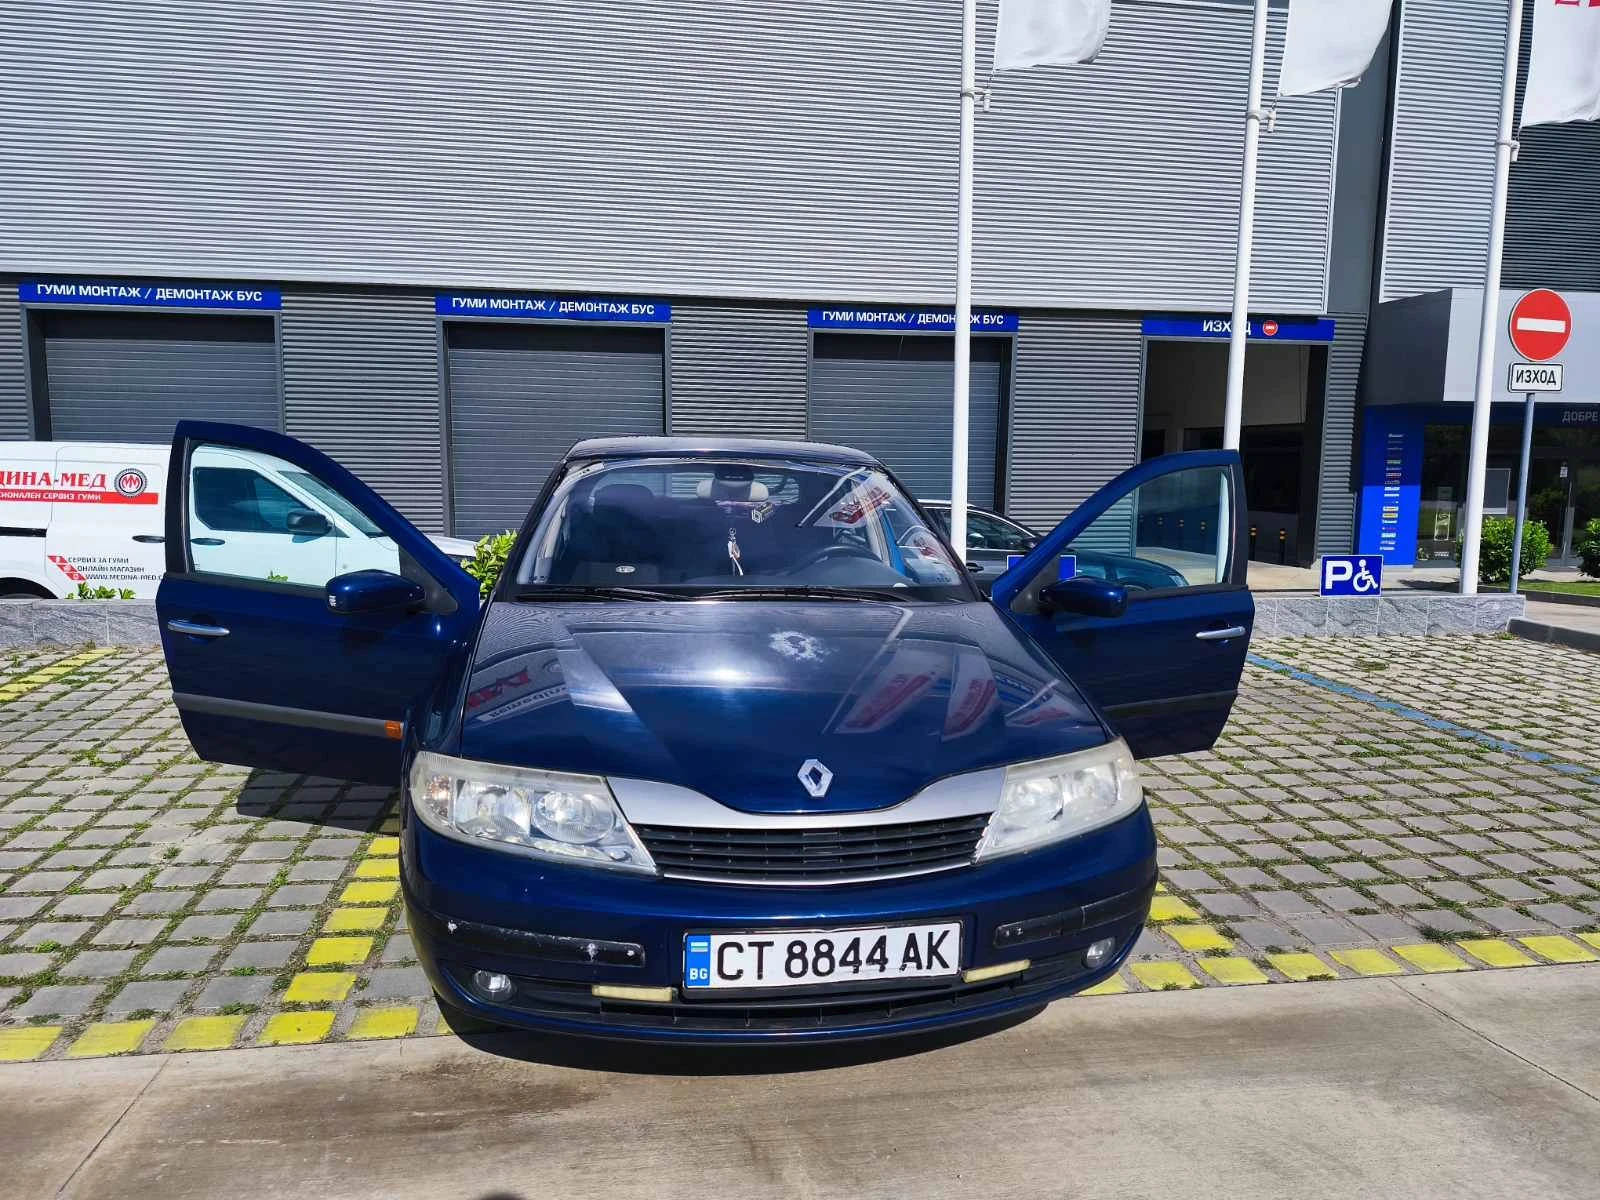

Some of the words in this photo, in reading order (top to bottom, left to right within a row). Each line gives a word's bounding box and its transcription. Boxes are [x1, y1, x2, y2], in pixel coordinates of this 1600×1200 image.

[37, 284, 76, 296] ГУМИ
[79, 285, 141, 298] МОНТАЖ
[144, 287, 152, 299] /
[155, 288, 234, 301] ДЕМОНТАЖ
[237, 291, 263, 302] БУС
[452, 297, 487, 309] ГУМИ
[490, 299, 546, 311] МОНТАЖ
[549, 301, 555, 312] /
[558, 301, 630, 314] ДЕМОНТАЖ
[631, 304, 655, 315] БУС
[822, 311, 854, 321] ГУМИ
[856, 312, 906, 323] МОНТАЖ
[908, 313, 915, 324] /
[917, 313, 980, 325] ДЕМОНЖ
[983, 314, 1004, 325] БУС
[1202, 319, 1252, 336] ИЗХД
[1515, 369, 1557, 386] ИЗХОД
[43, 492, 74, 501] СЕРВИЗ
[77, 493, 101, 501] ГУМИ
[1325, 559, 1356, 589] P
[717, 940, 774, 981] CT
[784, 934, 889, 980] 8844
[899, 929, 951, 971] AK
[689, 968, 708, 981] BG
